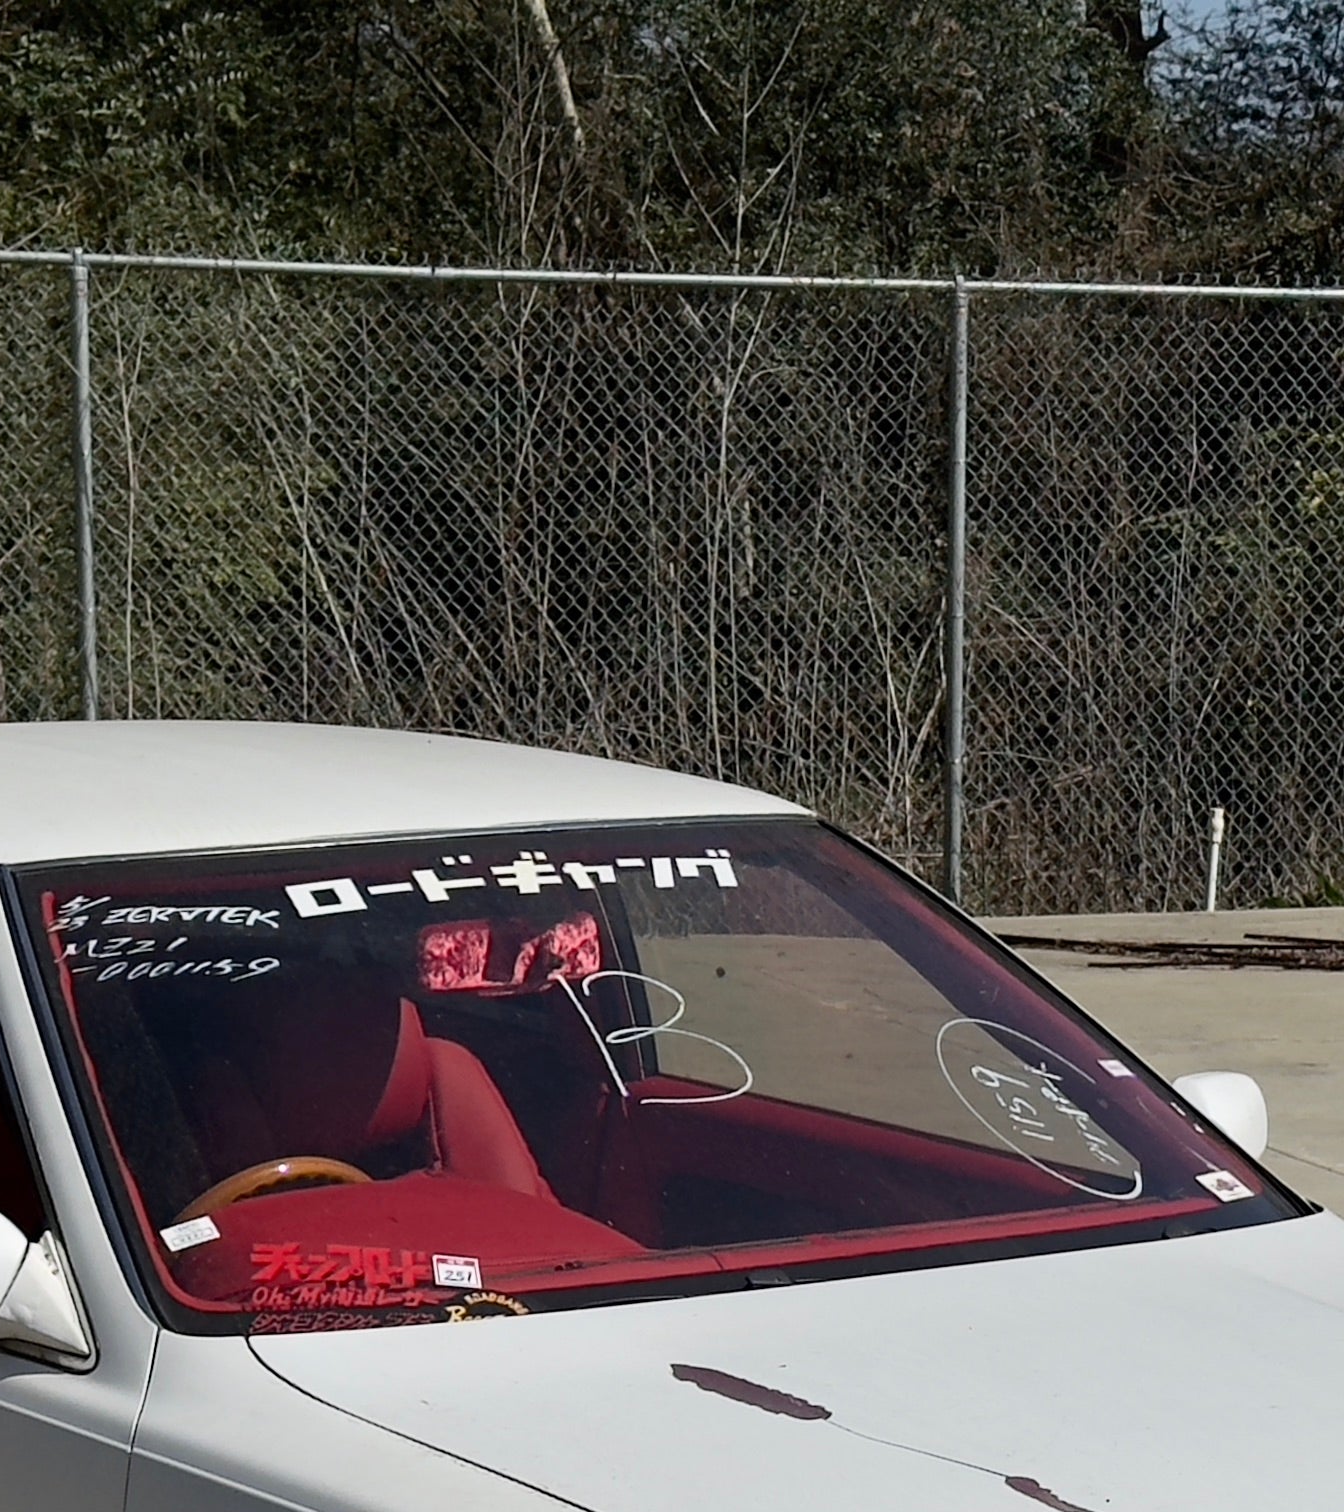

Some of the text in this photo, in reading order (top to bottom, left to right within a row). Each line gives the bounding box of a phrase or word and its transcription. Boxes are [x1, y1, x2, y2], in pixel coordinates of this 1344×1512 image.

[285, 849, 739, 918] ロードギャング
